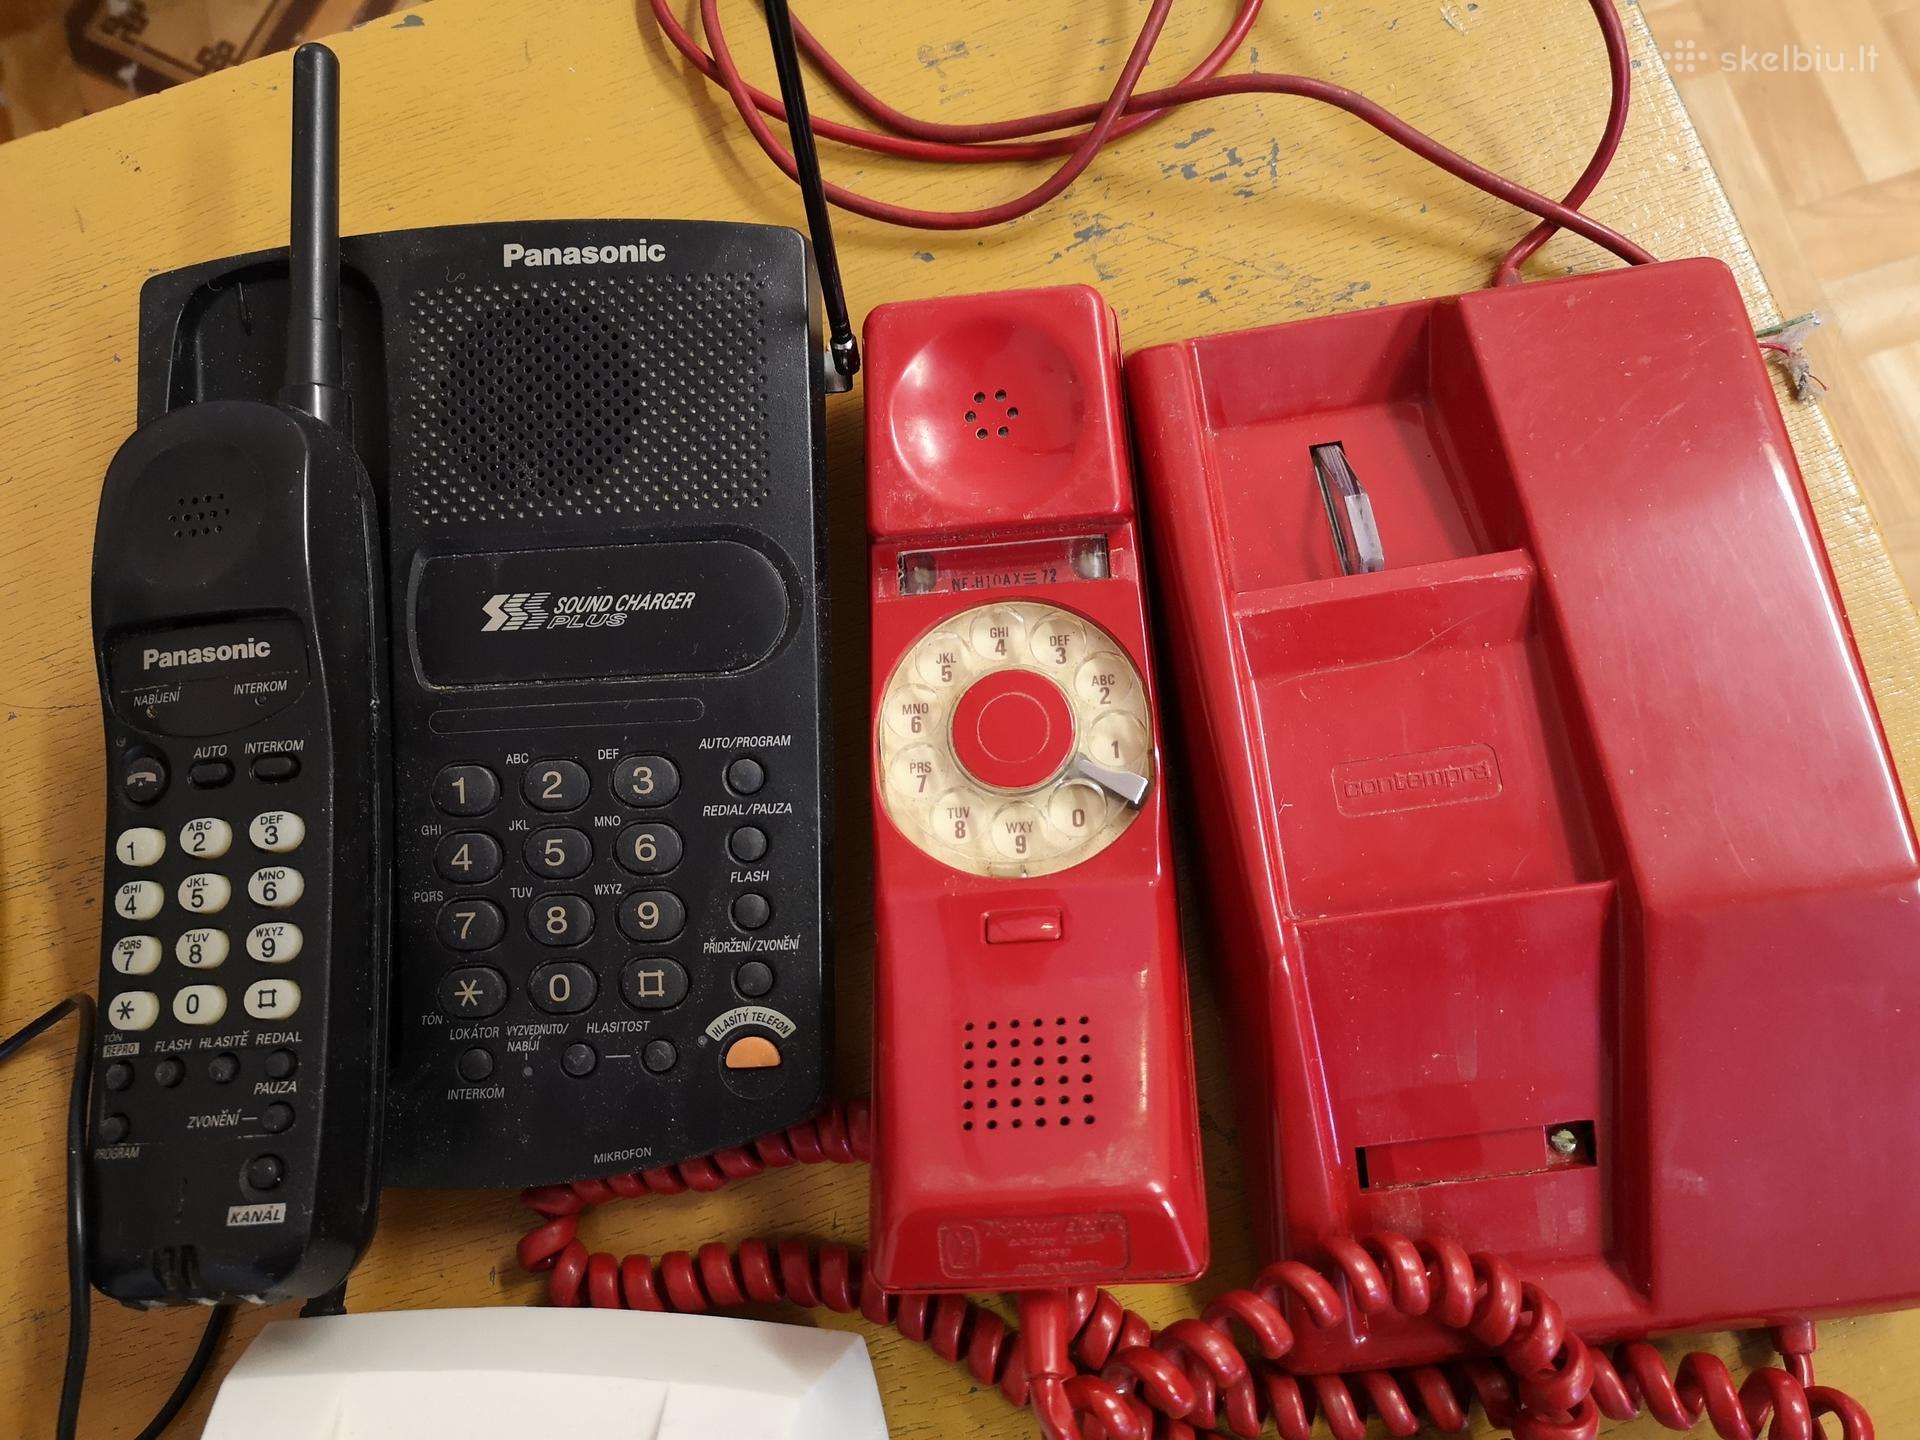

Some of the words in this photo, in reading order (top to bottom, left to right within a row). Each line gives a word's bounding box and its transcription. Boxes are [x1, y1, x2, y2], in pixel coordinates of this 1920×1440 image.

[503, 238, 667, 267] Panasonic
[553, 594, 613, 614] SOUND
[614, 592, 696, 613] CHARGER
[547, 612, 628, 629] PLUS
[989, 627, 1010, 639] GHI
[1049, 635, 1071, 647] DEF
[143, 637, 272, 670] Panasonic
[994, 638, 1008, 656] 4
[1055, 647, 1068, 665] 3
[935, 652, 957, 664] JKL
[941, 665, 953, 683] 5
[1091, 673, 1116, 687] ABC
[233, 680, 288, 696] INTERKOM
[1099, 687, 1112, 705] 2
[901, 703, 930, 715] MNO
[910, 715, 923, 734] 6
[193, 745, 228, 760] AUTO
[244, 739, 305, 754] INTERKOM
[699, 735, 792, 750] AUTO/PROGRAM
[1111, 740, 1121, 759] 1
[505, 752, 529, 765] ABC
[597, 748, 620, 760] DEF
[909, 761, 932, 774] PRS
[541, 770, 563, 799] 2
[632, 766, 655, 794] 3
[916, 774, 928, 793] 7
[451, 776, 466, 804] 1
[702, 802, 793, 817] REDIAL/PAUZA
[947, 807, 970, 820] TUV
[187, 820, 213, 832] ABC
[260, 814, 284, 826] DEF
[508, 818, 530, 831] JKL
[594, 815, 621, 828] MNO
[1005, 821, 1034, 833] WXY
[264, 825, 279, 846] 3
[420, 824, 442, 836] GHI
[954, 820, 967, 839] 8
[192, 831, 207, 852] 2
[634, 833, 657, 862] 6
[1015, 834, 1028, 854] 9
[126, 841, 136, 861] 1
[450, 843, 473, 872] 4
[544, 838, 566, 867] 5
[186, 877, 209, 889] JKL
[257, 870, 286, 882] MNO
[730, 870, 770, 884] FLASH
[122, 884, 142, 896] GHI
[190, 888, 205, 909] 5
[262, 881, 278, 902] 6
[413, 890, 444, 903] PQRS
[510, 886, 534, 899] TUV
[593, 884, 623, 896] WXYZ
[125, 895, 137, 915] 4
[546, 905, 568, 935] 8
[637, 901, 660, 930] 9
[255, 926, 285, 938] WXYZ
[455, 911, 477, 940] 7
[185, 932, 210, 944] TUV
[188, 943, 203, 965] 8
[260, 937, 277, 959] 9
[122, 950, 136, 972] 7
[549, 973, 571, 1002] 0
[185, 993, 200, 1015] 0
[449, 1022, 500, 1041] LOKÁTOR
[586, 1020, 650, 1034] HLASITOST
[751, 1011, 792, 1034] TELEFON
[154, 1038, 193, 1052] FLASH
[199, 1030, 250, 1048] HLASITĚ
[255, 1031, 303, 1045] REDIAL
[253, 1080, 298, 1095] PAUZA
[447, 1086, 506, 1101] INTERKOM
[593, 1146, 653, 1164] MIKROFON
[228, 1205, 282, 1224] KANÁL
